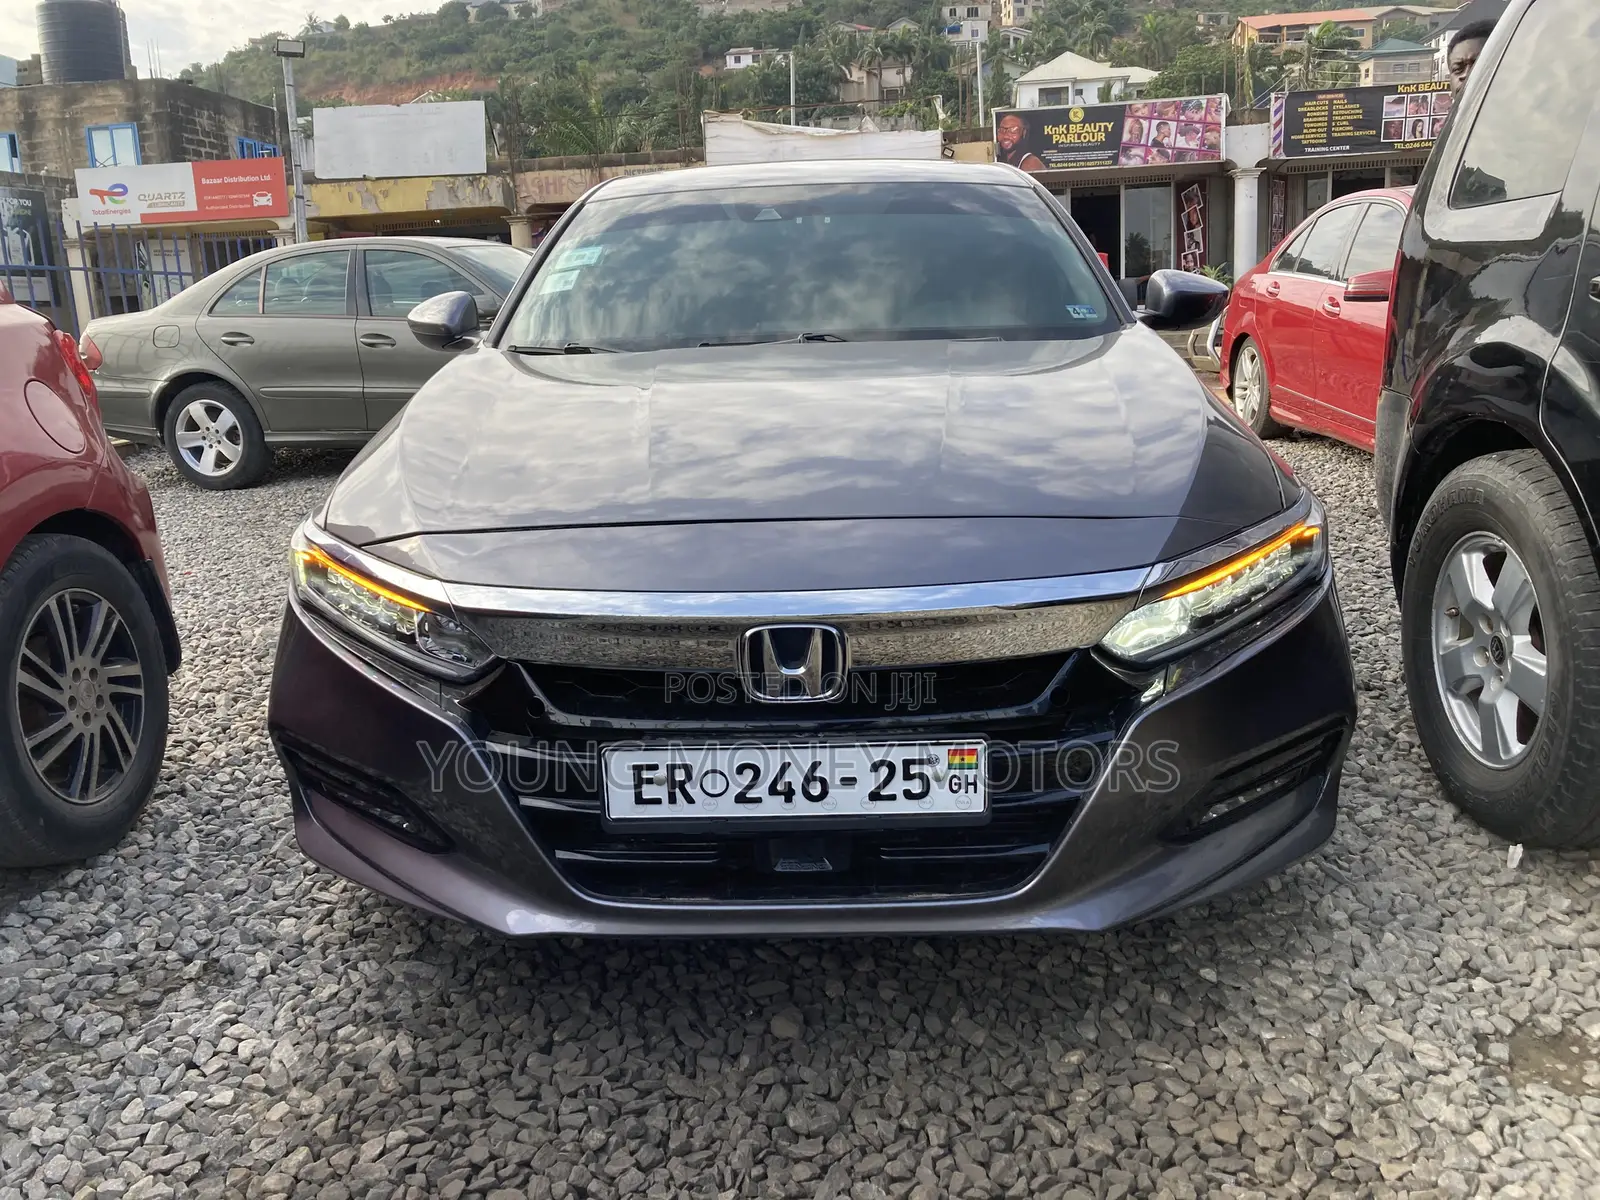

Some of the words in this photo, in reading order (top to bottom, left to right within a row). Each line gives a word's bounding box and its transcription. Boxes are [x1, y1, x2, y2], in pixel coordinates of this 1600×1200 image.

[1398, 84, 1417, 93] KnK
[1418, 82, 1450, 91] BEAUT
[1044, 124, 1067, 135] KnK
[1069, 122, 1114, 134] BEAUTY
[1052, 132, 1105, 144] PARLOUR
[201, 177, 223, 185] Bazaar
[224, 175, 259, 184] Distribution
[137, 191, 185, 202] QUARTZ
[19, 199, 32, 207] YOU
[92, 208, 131, 216] TotalEnergies
[632, 763, 696, 805] ER
[948, 774, 978, 794] GH
